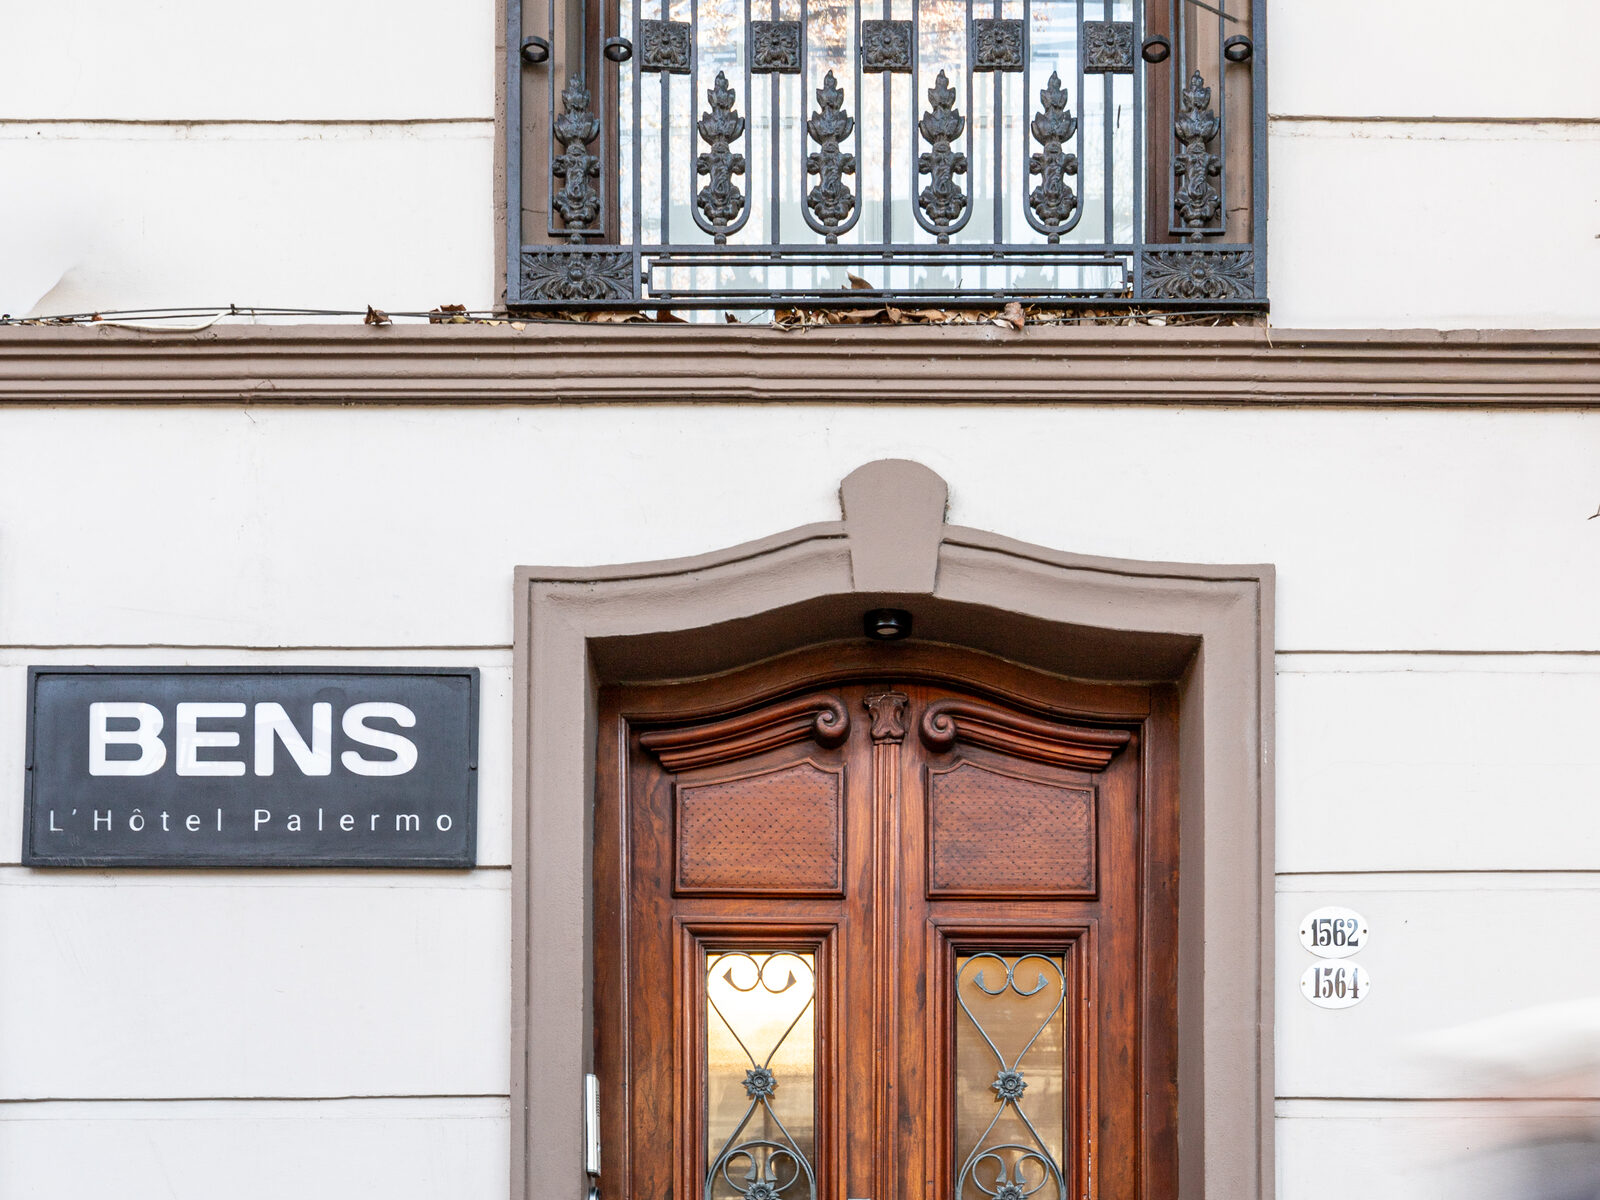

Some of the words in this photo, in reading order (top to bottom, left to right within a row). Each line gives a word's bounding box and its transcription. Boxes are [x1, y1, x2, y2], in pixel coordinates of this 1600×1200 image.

[88, 701, 419, 777] BENS
[48, 808, 222, 832] L'Hôtel
[253, 807, 453, 832] Palermo
[1310, 918, 1359, 947] 1562
[1312, 967, 1360, 999] 1564
